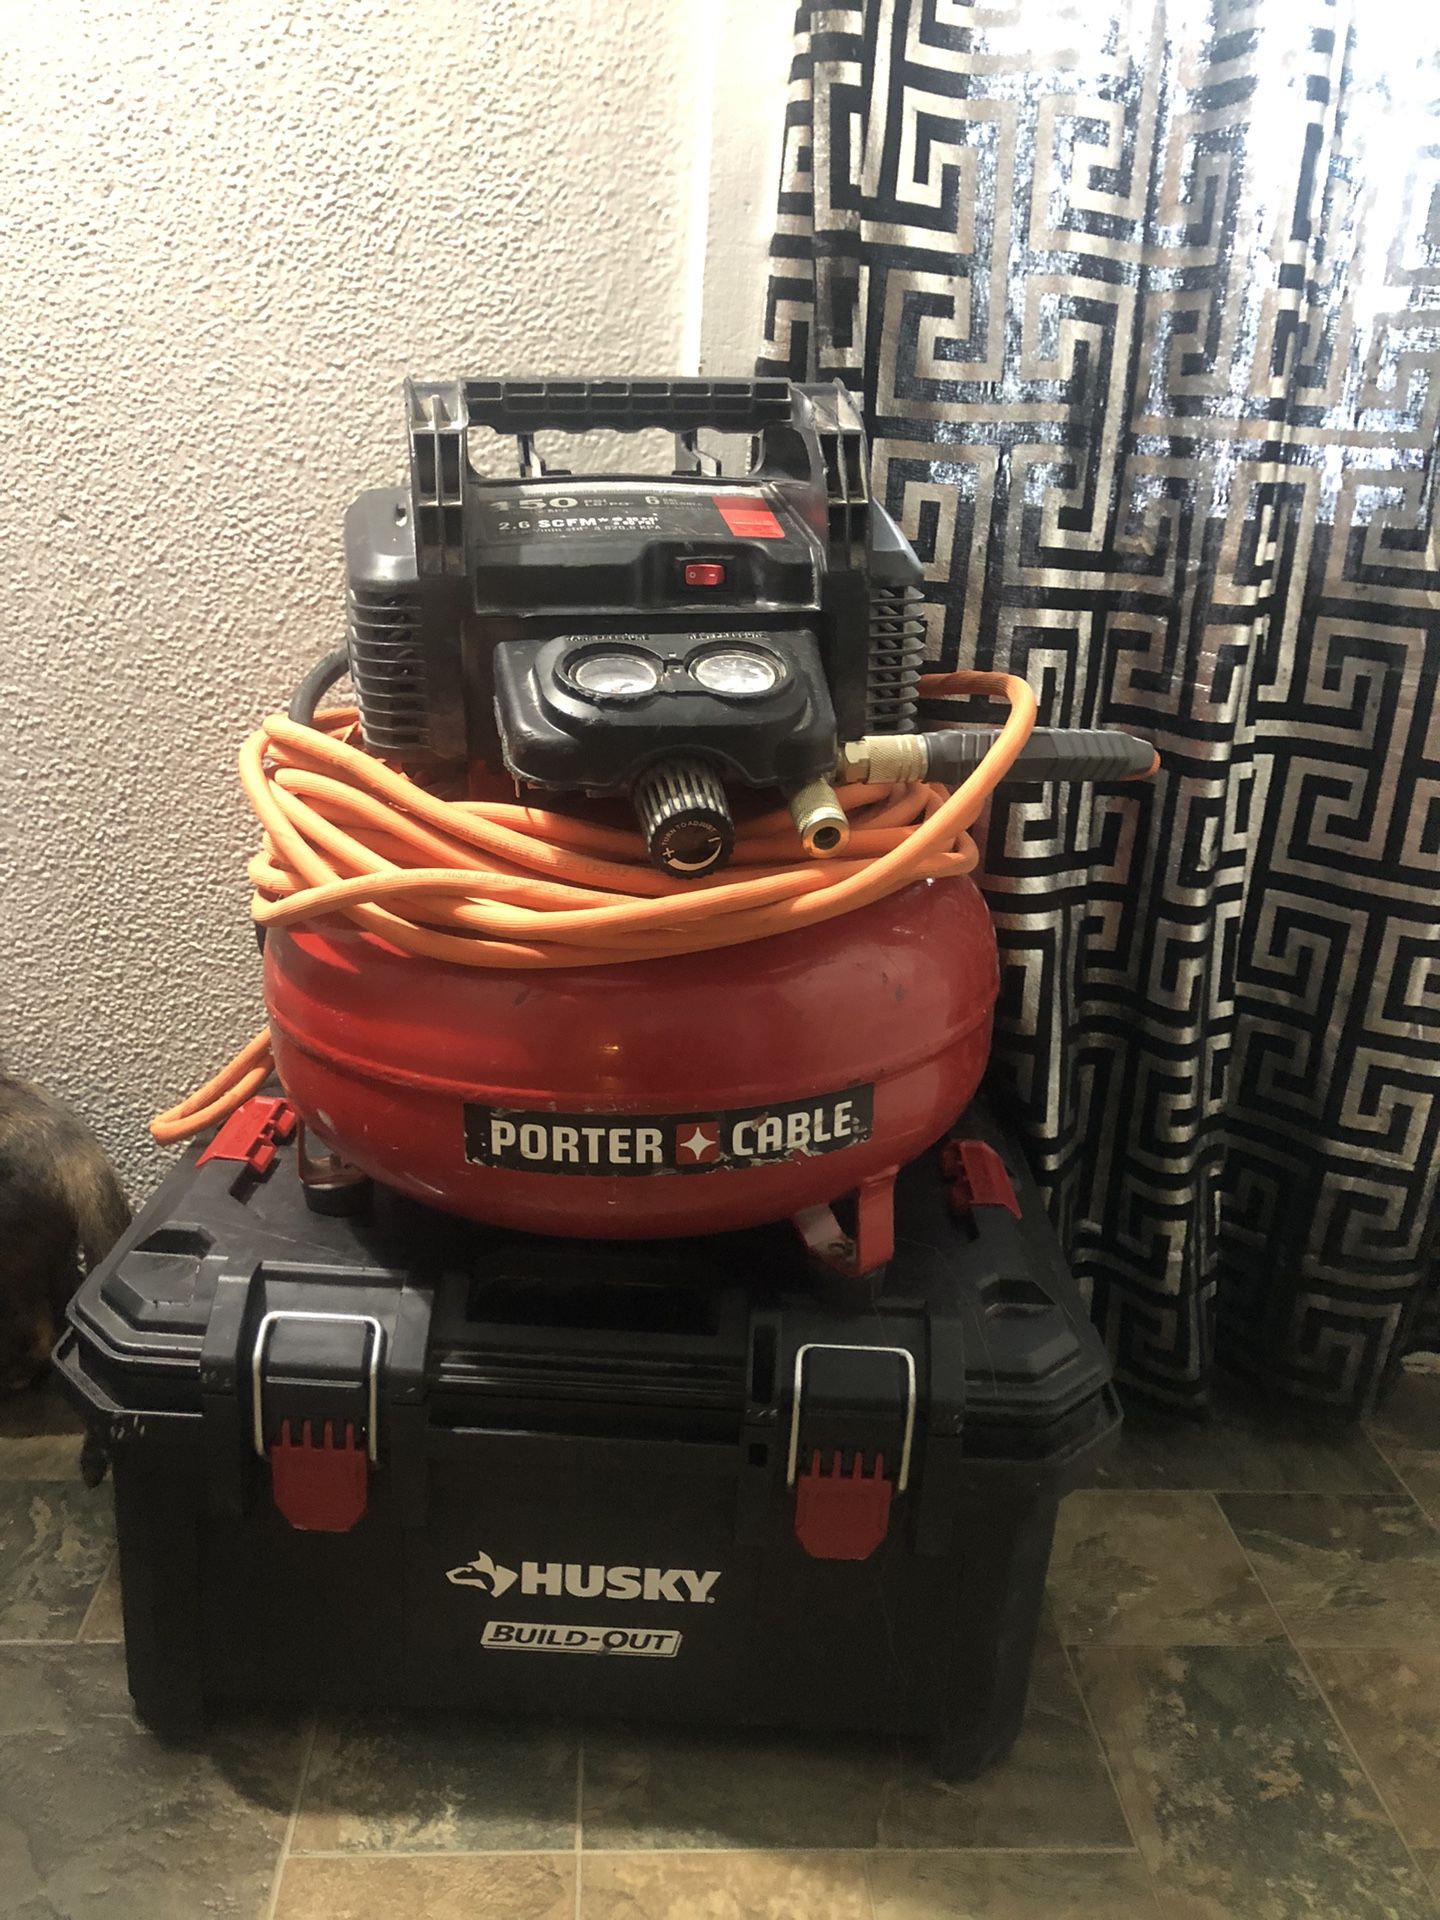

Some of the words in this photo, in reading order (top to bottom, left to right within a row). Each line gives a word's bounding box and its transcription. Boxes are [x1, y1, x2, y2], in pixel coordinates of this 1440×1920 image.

[490, 497, 578, 511] 150
[499, 520, 530, 531] 2.6
[661, 828, 677, 846] TURN
[490, 1118, 664, 1164] PORTER
[732, 1100, 854, 1156] CABLE
[520, 1560, 722, 1603] HUSKY
[487, 1623, 673, 1651] BUILD-OUT
